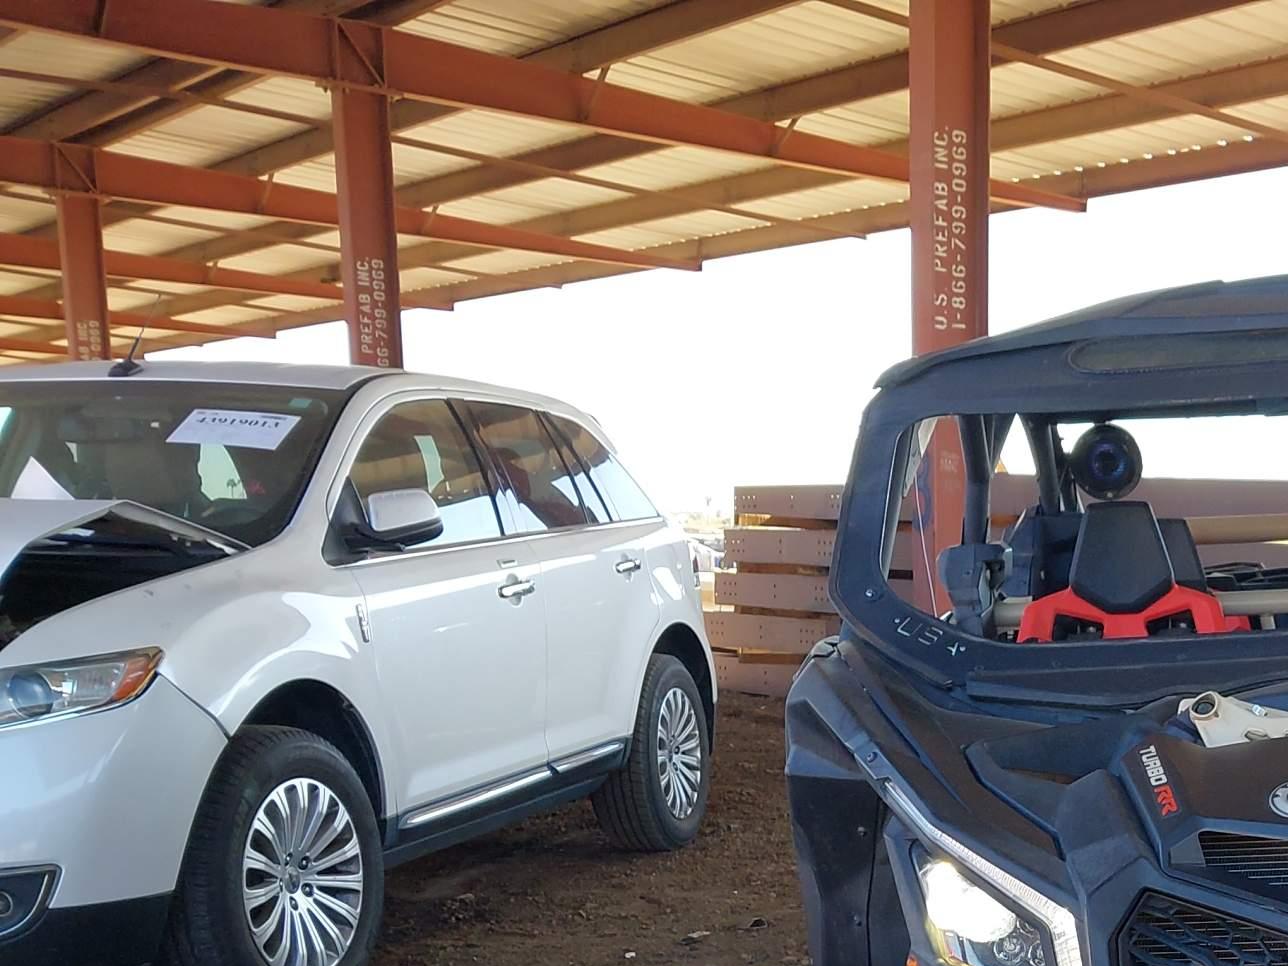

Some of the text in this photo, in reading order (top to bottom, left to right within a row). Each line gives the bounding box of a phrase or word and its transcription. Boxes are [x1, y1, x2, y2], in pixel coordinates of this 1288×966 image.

[934, 125, 949, 330] U.S. PREFAB INC.
[951, 129, 967, 330] 1-866-799-0969
[356, 256, 375, 355] PREFAB INC.
[1139, 745, 1168, 787] TURBO
